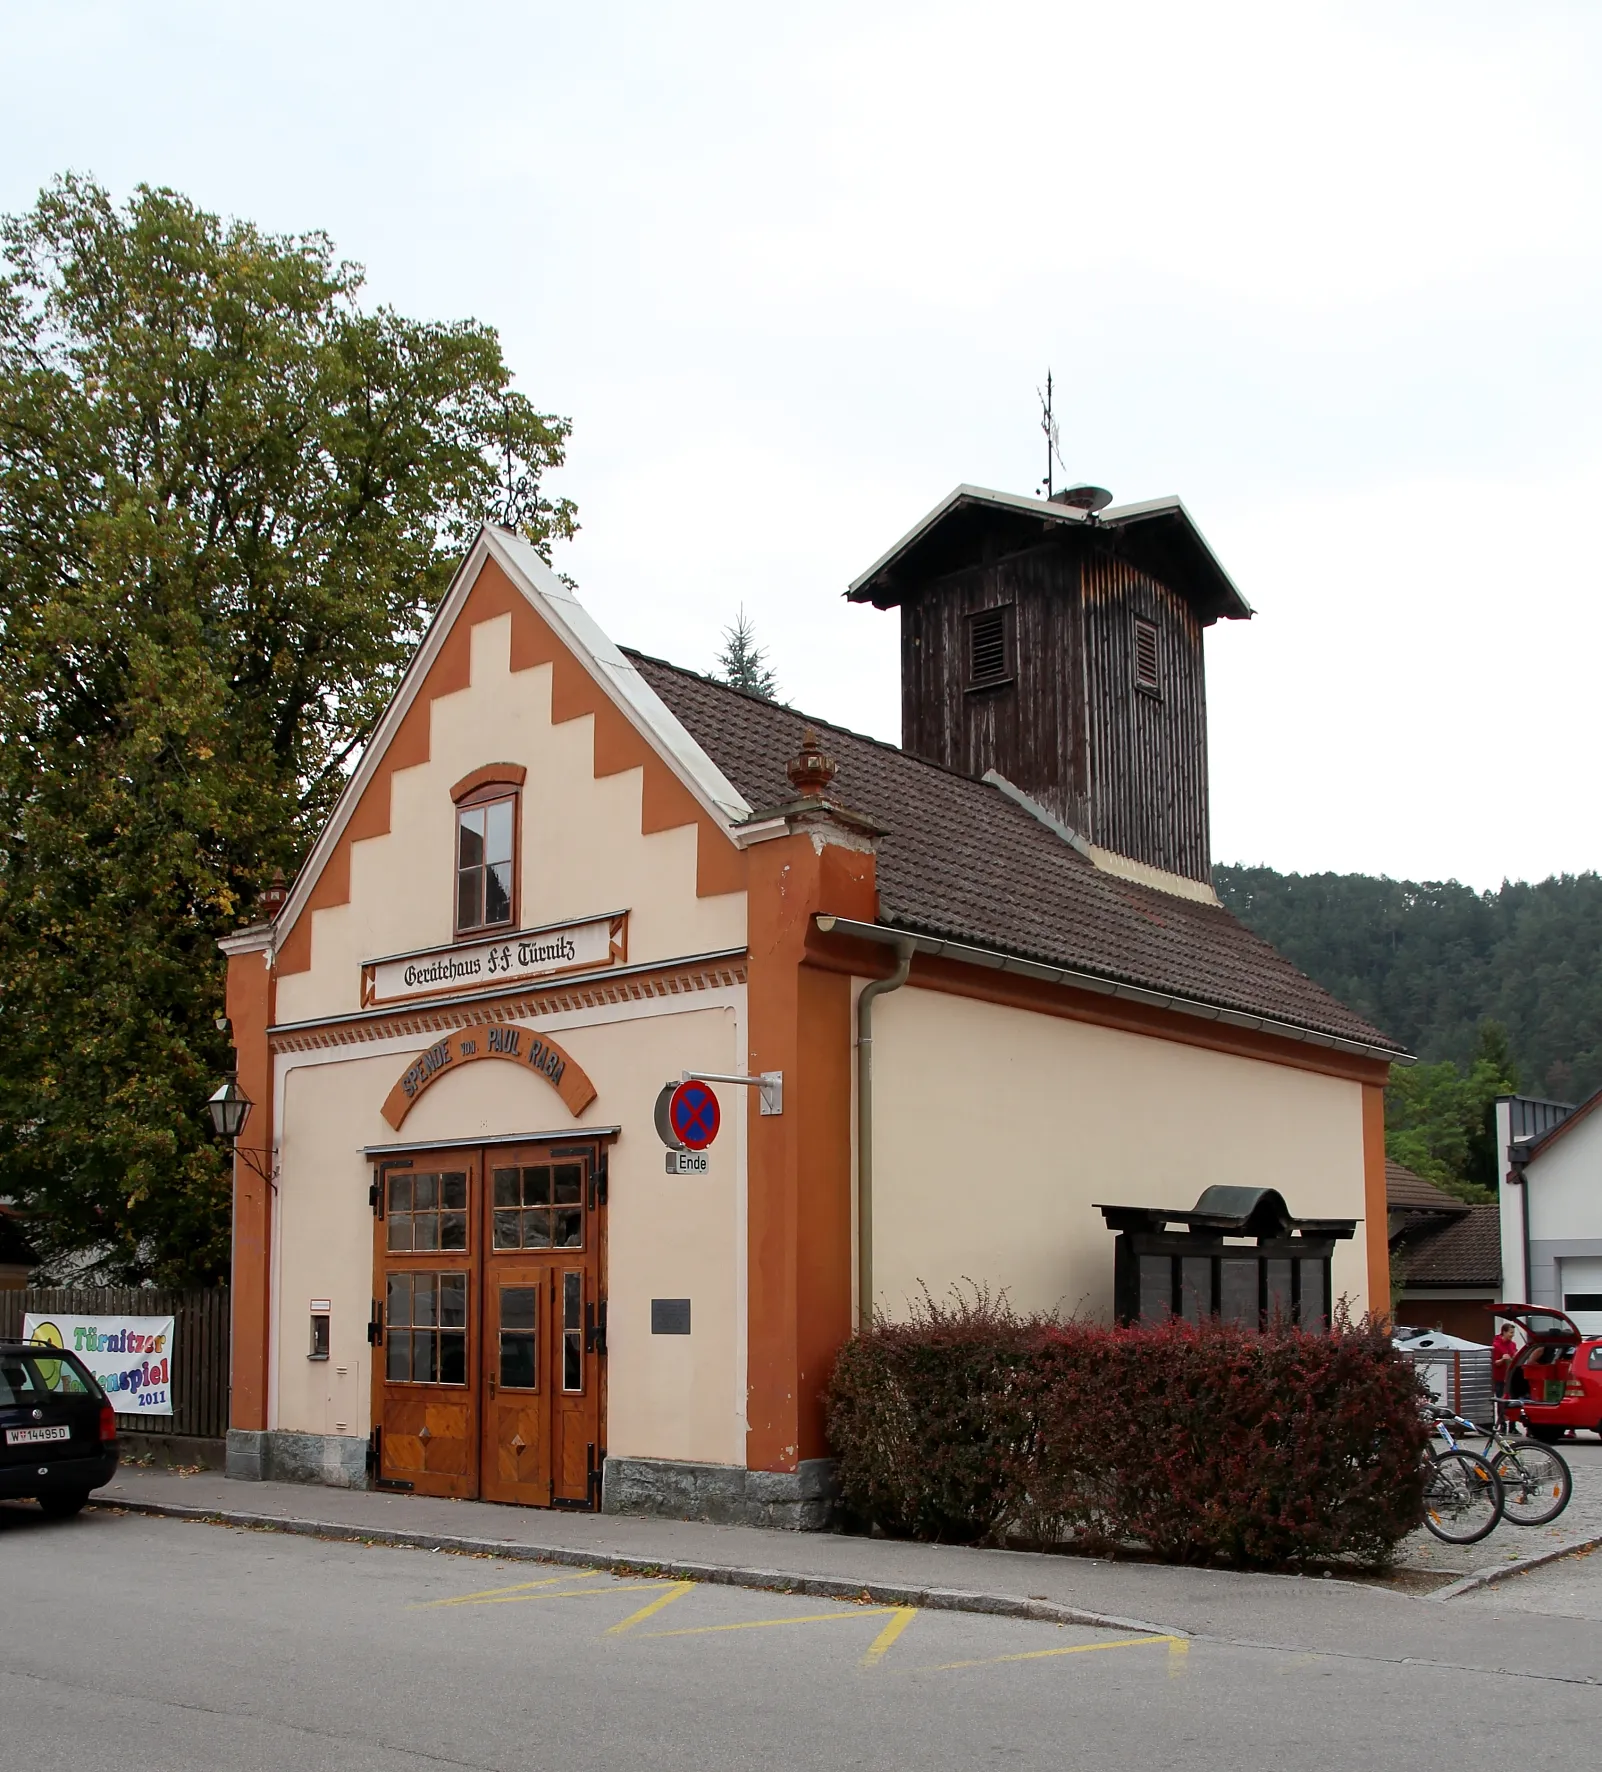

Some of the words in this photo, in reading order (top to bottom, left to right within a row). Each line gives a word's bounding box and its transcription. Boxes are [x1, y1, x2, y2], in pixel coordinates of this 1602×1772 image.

[518, 936, 575, 967] Türnitz
[402, 1039, 453, 1098] SPENDE
[487, 1027, 520, 1056] PAUL
[528, 1040, 566, 1086] RABA
[679, 1155, 707, 1170] Ende
[73, 1326, 166, 1354] Türnitzer
[138, 1390, 166, 1406] 2011
[11, 1431, 19, 1442] W
